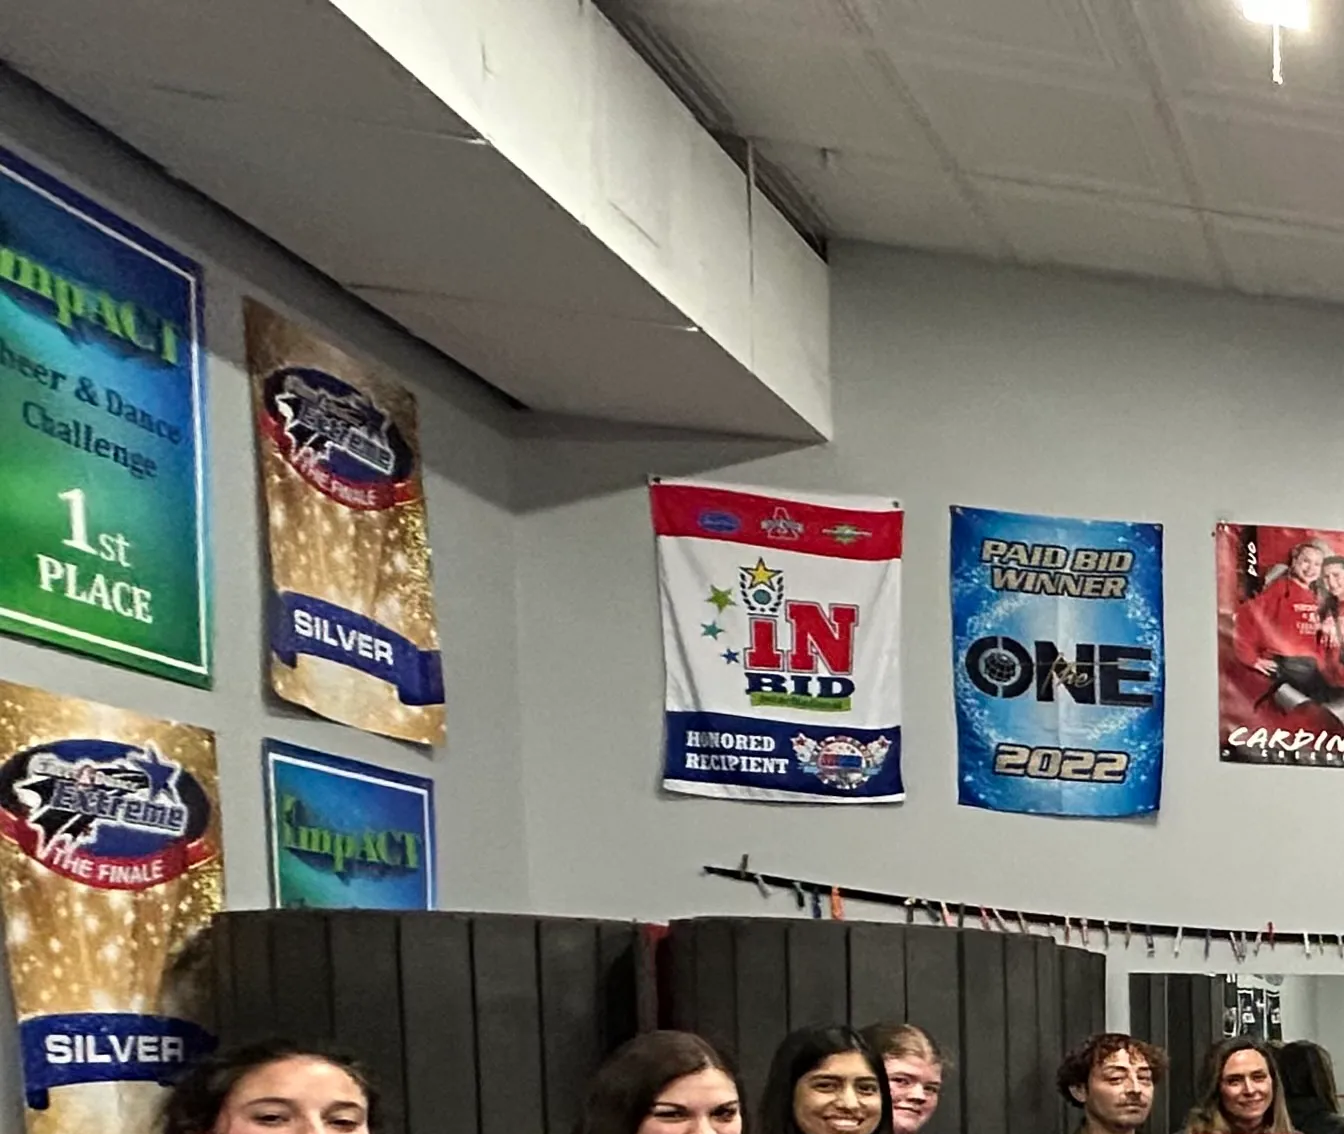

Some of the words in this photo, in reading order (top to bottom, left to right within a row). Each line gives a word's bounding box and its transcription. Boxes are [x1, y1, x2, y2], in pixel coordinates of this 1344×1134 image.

[74, 375, 100, 407] &
[105, 387, 182, 445] Dance
[22, 400, 158, 479] Challenge
[57, 488, 132, 567] 1st
[981, 539, 1067, 569] PAID
[1072, 549, 1134, 573] BID
[36, 552, 153, 624] PLACE
[992, 568, 1127, 598] WINNER
[293, 609, 394, 666] SILVER
[745, 672, 856, 698] BID
[965, 636, 1153, 708] ONE
[685, 730, 776, 752] HONORED
[685, 752, 789, 775] RECIPIENT
[994, 742, 1130, 783] 2022
[51, 781, 188, 830] Extreme
[98, 859, 164, 884] FINALE
[45, 1033, 185, 1064] SILVER
